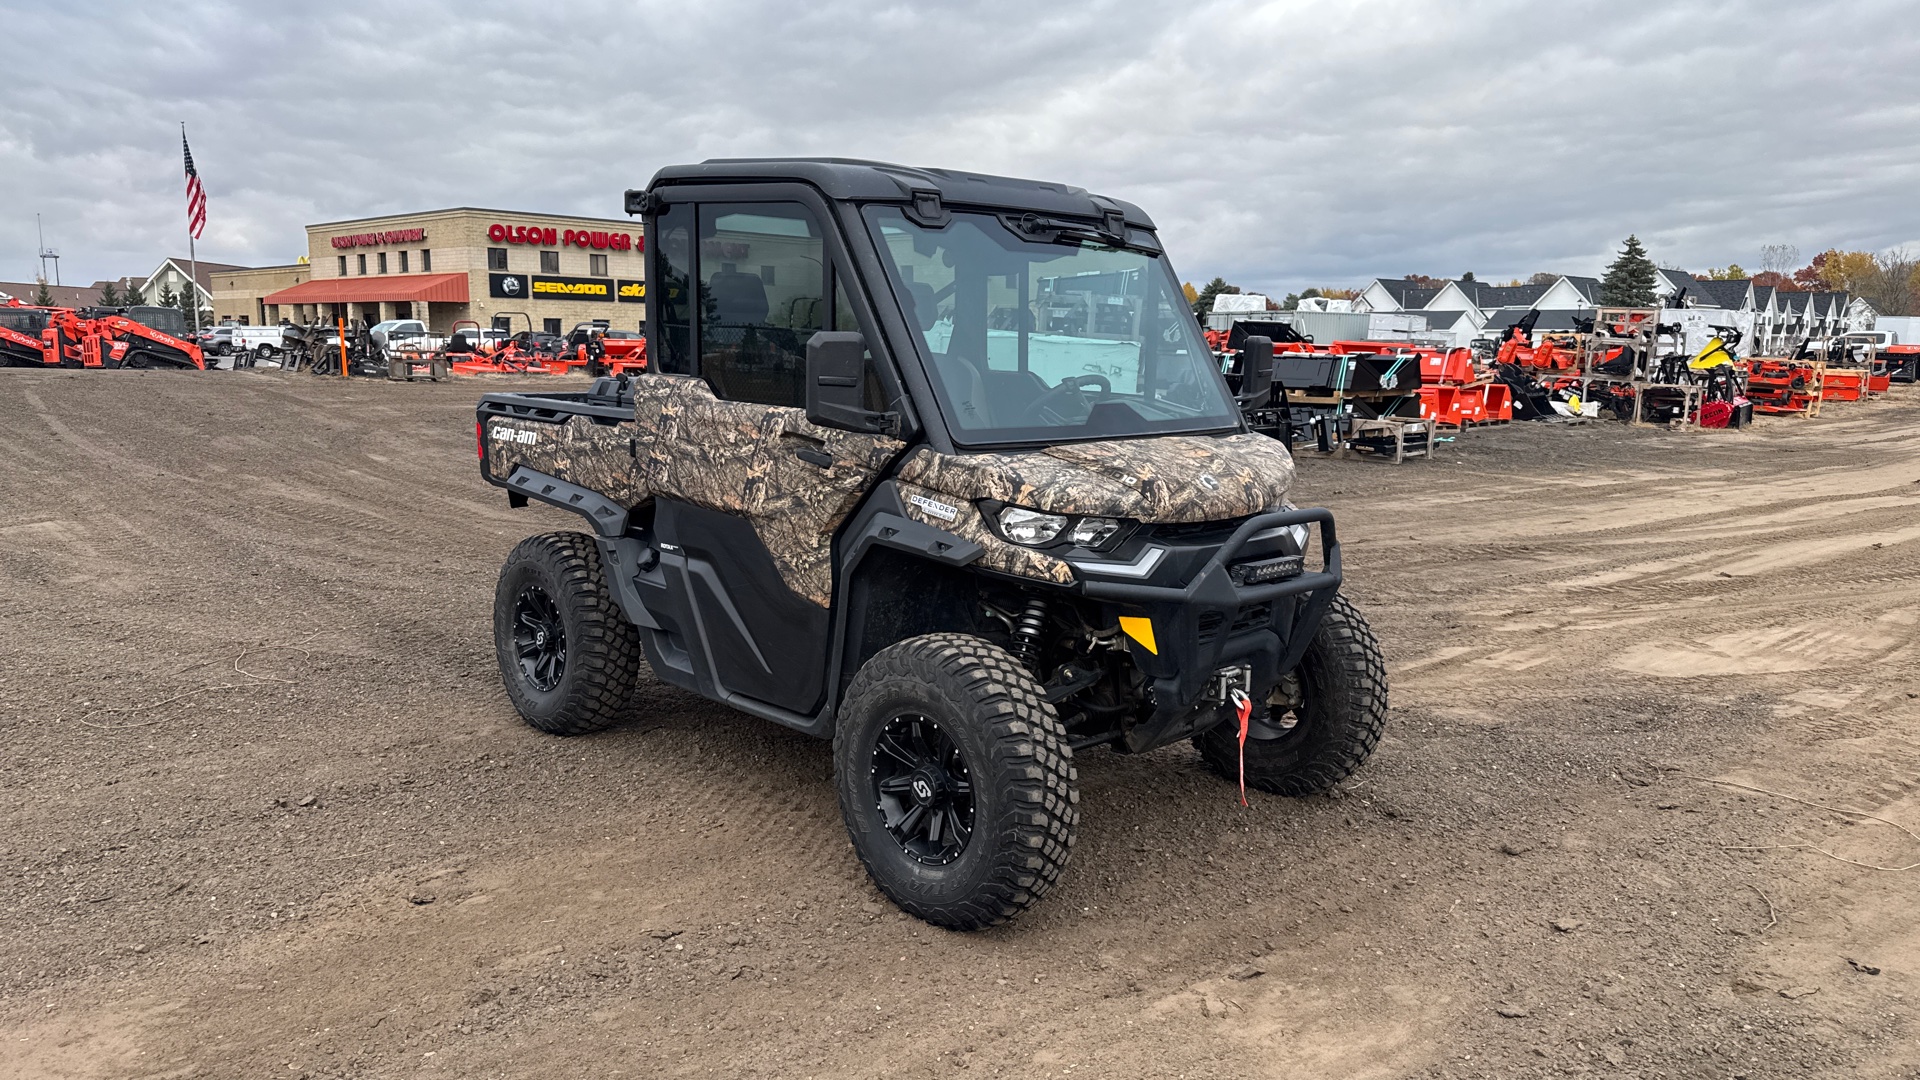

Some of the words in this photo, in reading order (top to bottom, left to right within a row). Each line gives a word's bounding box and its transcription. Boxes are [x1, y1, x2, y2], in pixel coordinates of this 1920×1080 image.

[384, 228, 424, 244] EQUIPMENT
[488, 223, 557, 246] OLSON
[563, 229, 631, 251] POWER
[11, 333, 37, 347] Kubota
[150, 331, 175, 346] Kubota
[492, 426, 537, 446] can-am
[911, 495, 957, 516] DEFENDER
